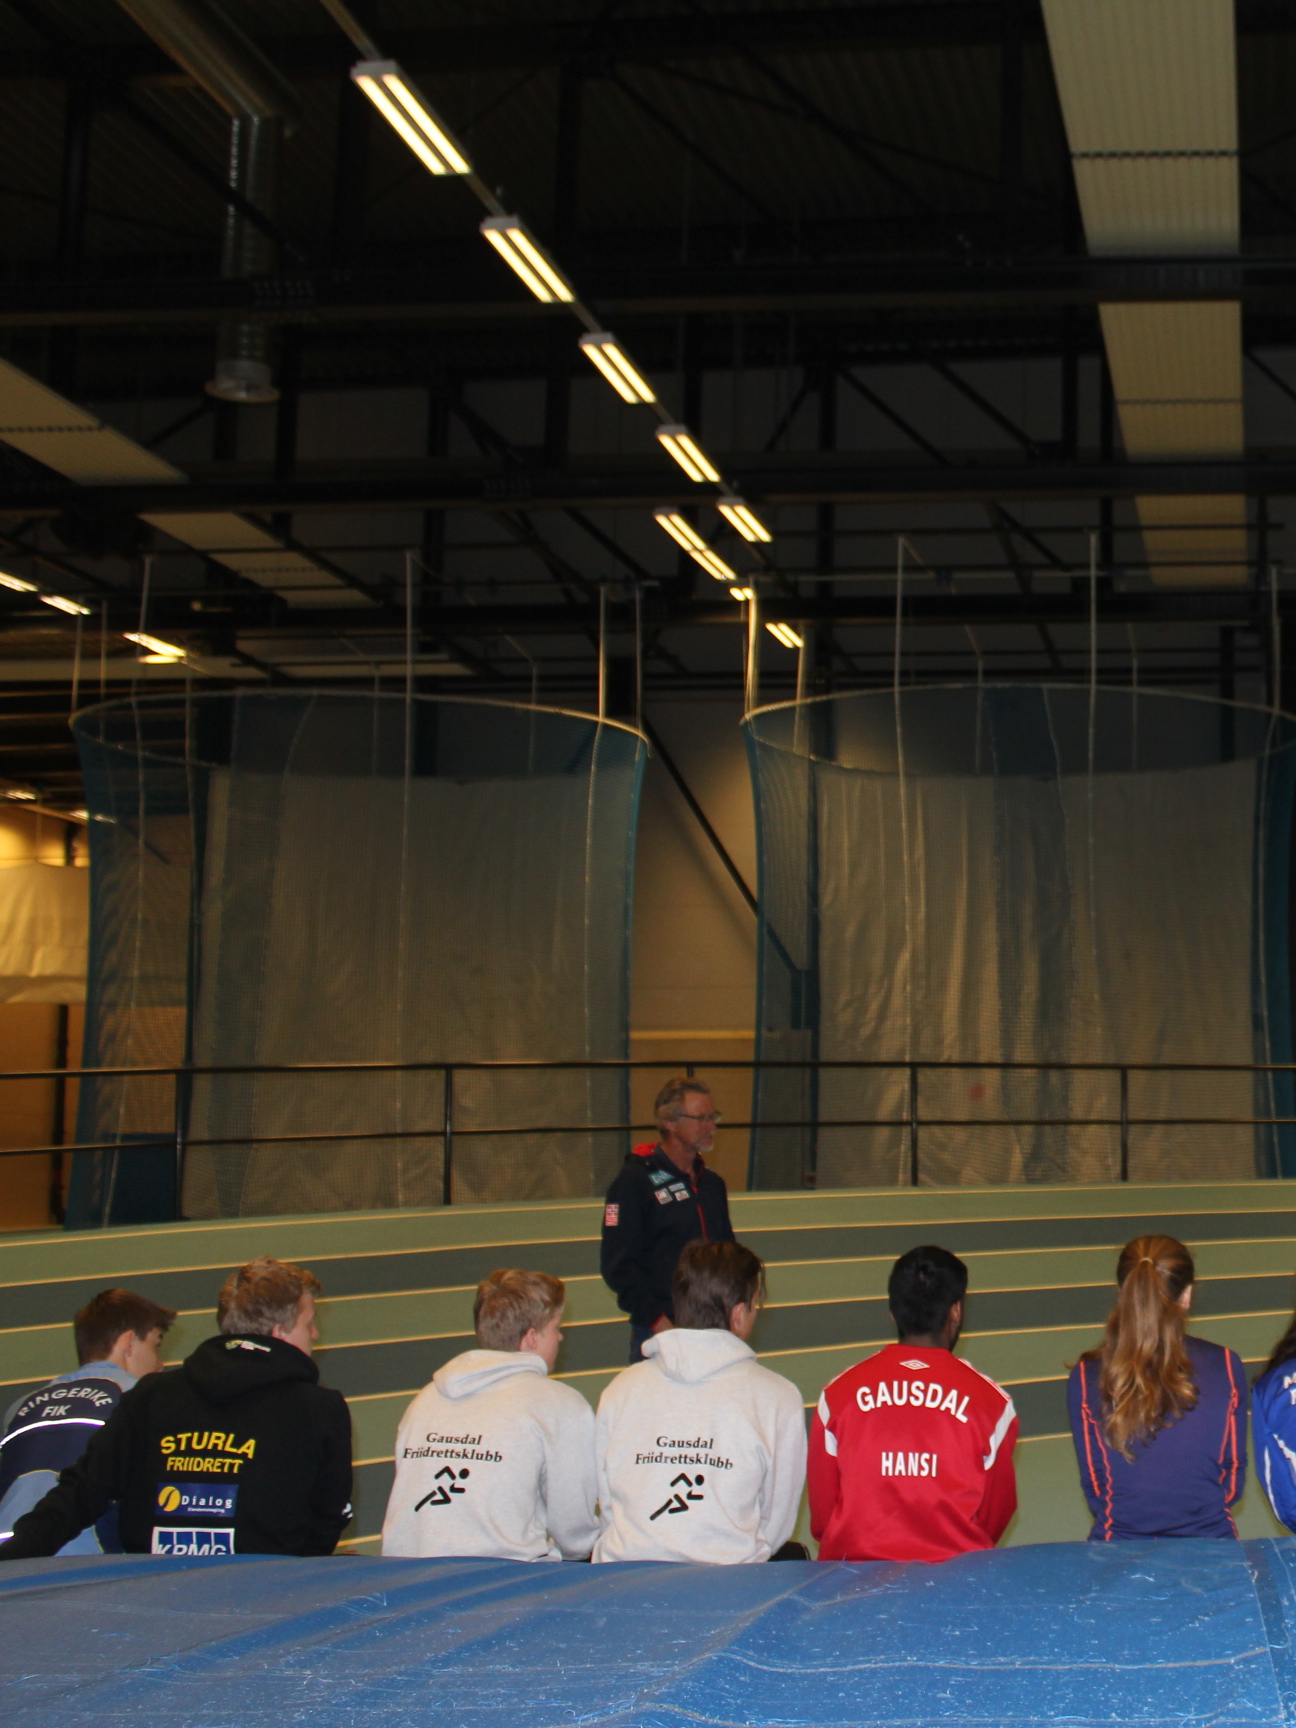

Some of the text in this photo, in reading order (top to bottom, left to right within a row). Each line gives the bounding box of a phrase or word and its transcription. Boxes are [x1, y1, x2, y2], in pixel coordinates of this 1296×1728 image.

[18, 1387, 113, 1417] RINGERIKE
[41, 1404, 72, 1418] FIK
[856, 1380, 970, 1424] GAUSDAL
[160, 1431, 256, 1459] STURLA
[426, 1432, 483, 1446] Gausdal
[656, 1435, 714, 1450] Gausdal
[402, 1446, 503, 1463] Friidrettsklubb
[635, 1452, 734, 1471] Friidrettsklubb
[166, 1456, 244, 1474] FRIIDRETT
[881, 1451, 938, 1478] HANSI
[181, 1495, 233, 1509] Dialog
